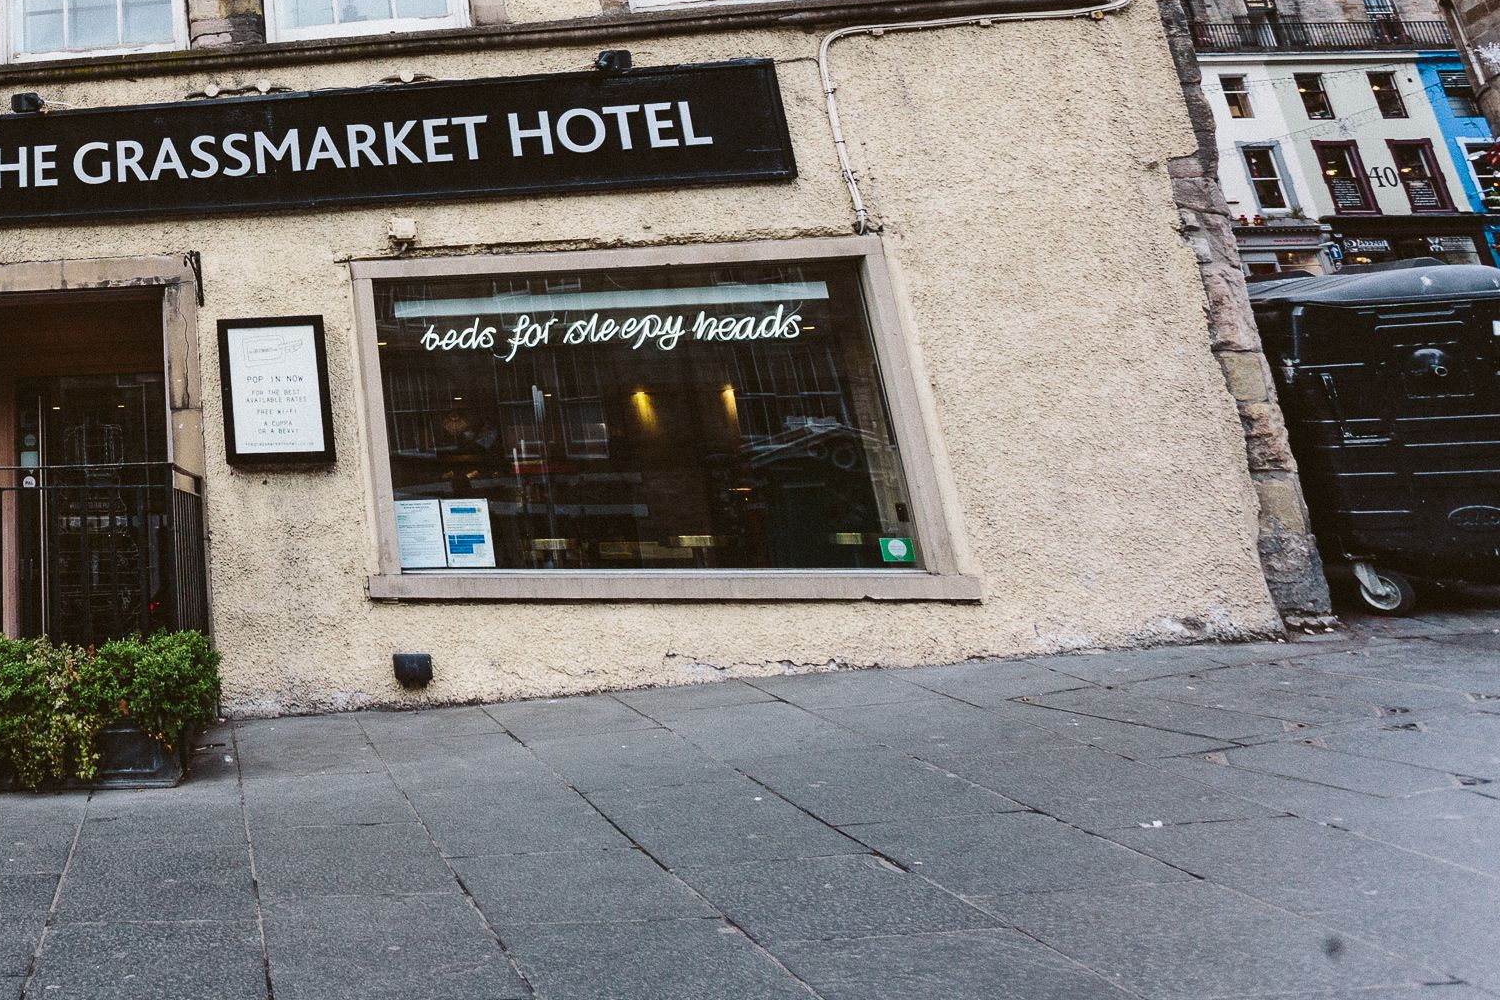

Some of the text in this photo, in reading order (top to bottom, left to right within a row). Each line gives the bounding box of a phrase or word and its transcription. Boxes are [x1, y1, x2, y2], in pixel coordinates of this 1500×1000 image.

[74, 115, 487, 184] GRASSMARKET
[508, 101, 713, 156] HOTEL
[1369, 166, 1398, 187] 40
[421, 304, 801, 362] beds for sleepy heads
[246, 375, 263, 383] POP
